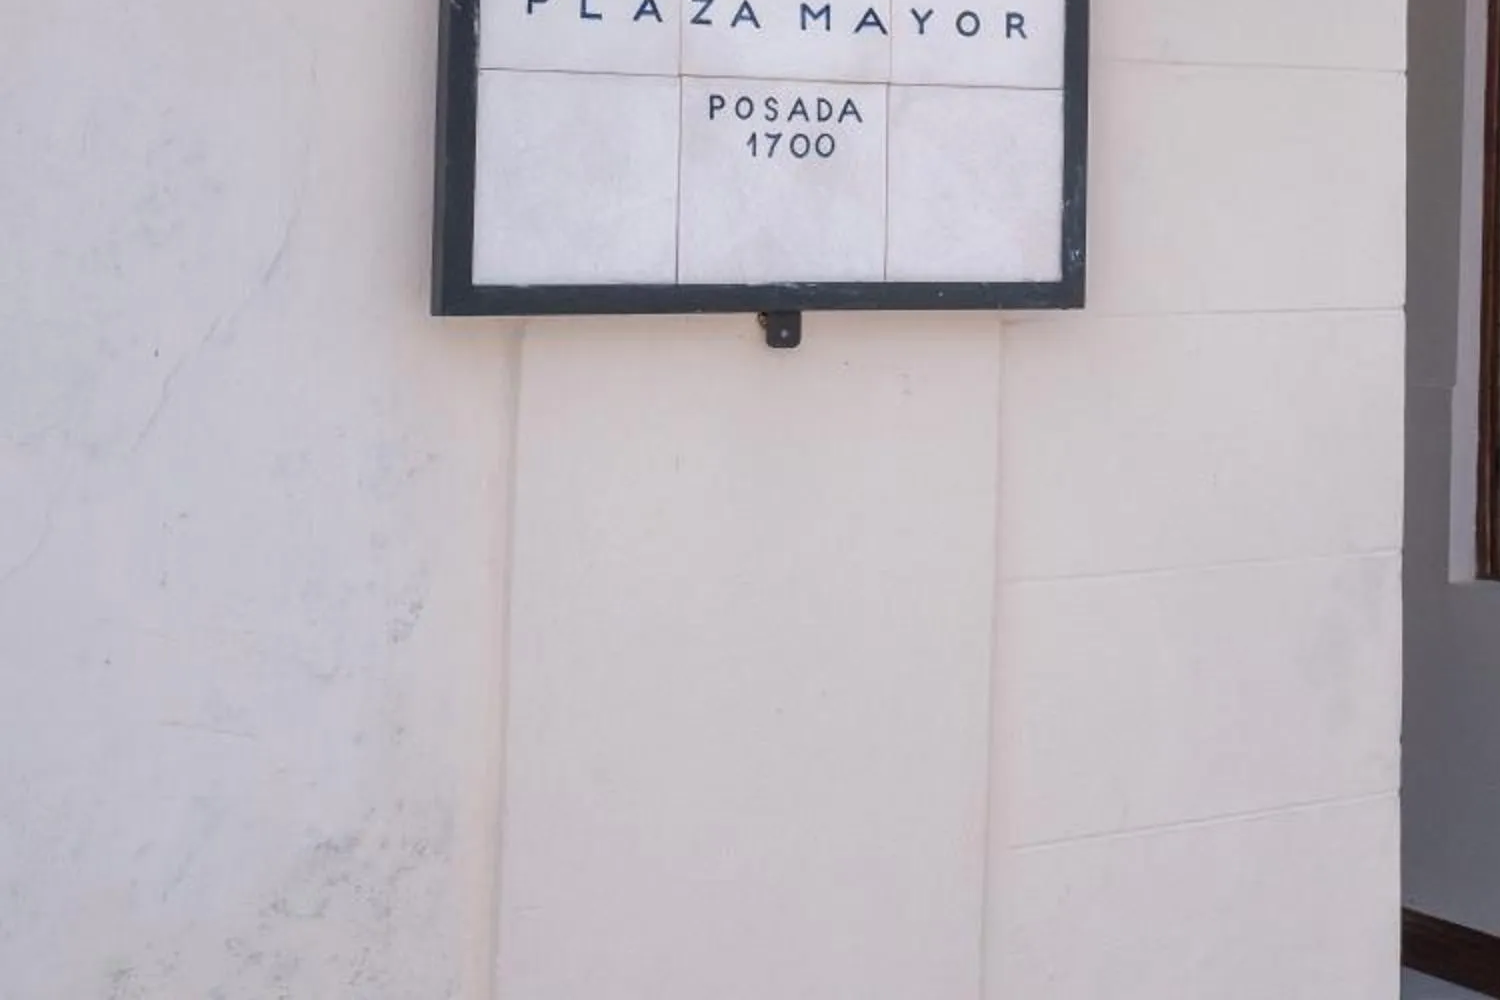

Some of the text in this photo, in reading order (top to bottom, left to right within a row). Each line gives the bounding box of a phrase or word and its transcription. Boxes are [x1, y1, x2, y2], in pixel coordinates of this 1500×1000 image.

[799, 2, 1028, 40] MAYOR
[708, 93, 863, 124] POSADA
[746, 131, 836, 160] 1700
